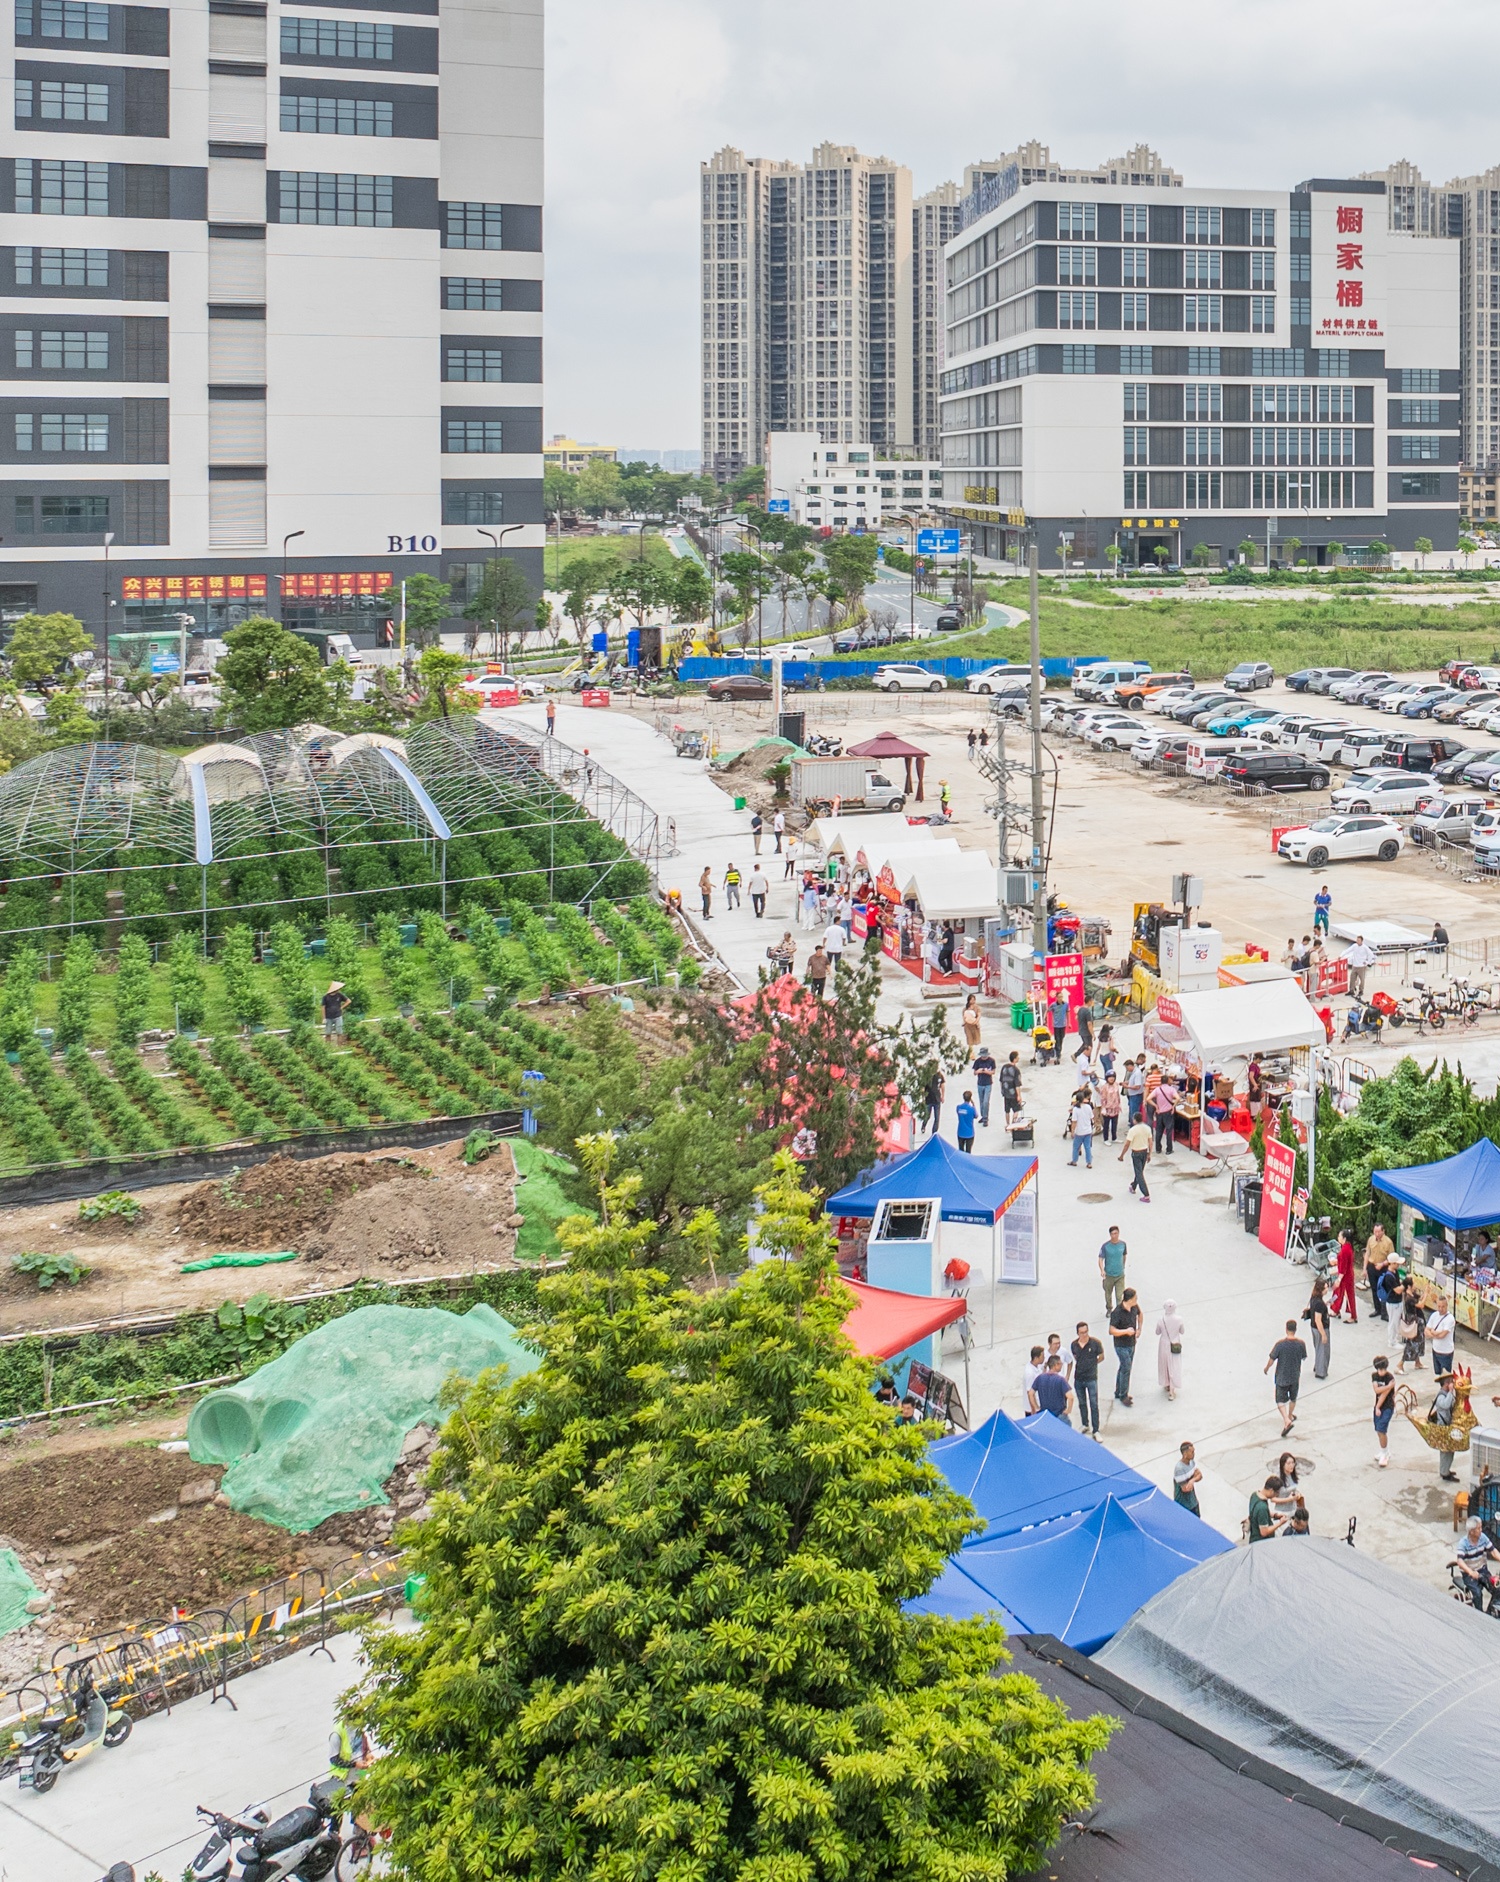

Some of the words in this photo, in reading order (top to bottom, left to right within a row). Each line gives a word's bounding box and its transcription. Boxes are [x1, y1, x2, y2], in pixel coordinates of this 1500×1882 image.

[1336, 206, 1363, 307] 橱家桶
[1322, 318, 1378, 330] 材料供应链
[387, 534, 437, 552] B10
[124, 576, 245, 590] 众兴旺不锈钢
[1195, 949, 1208, 960] 5G
